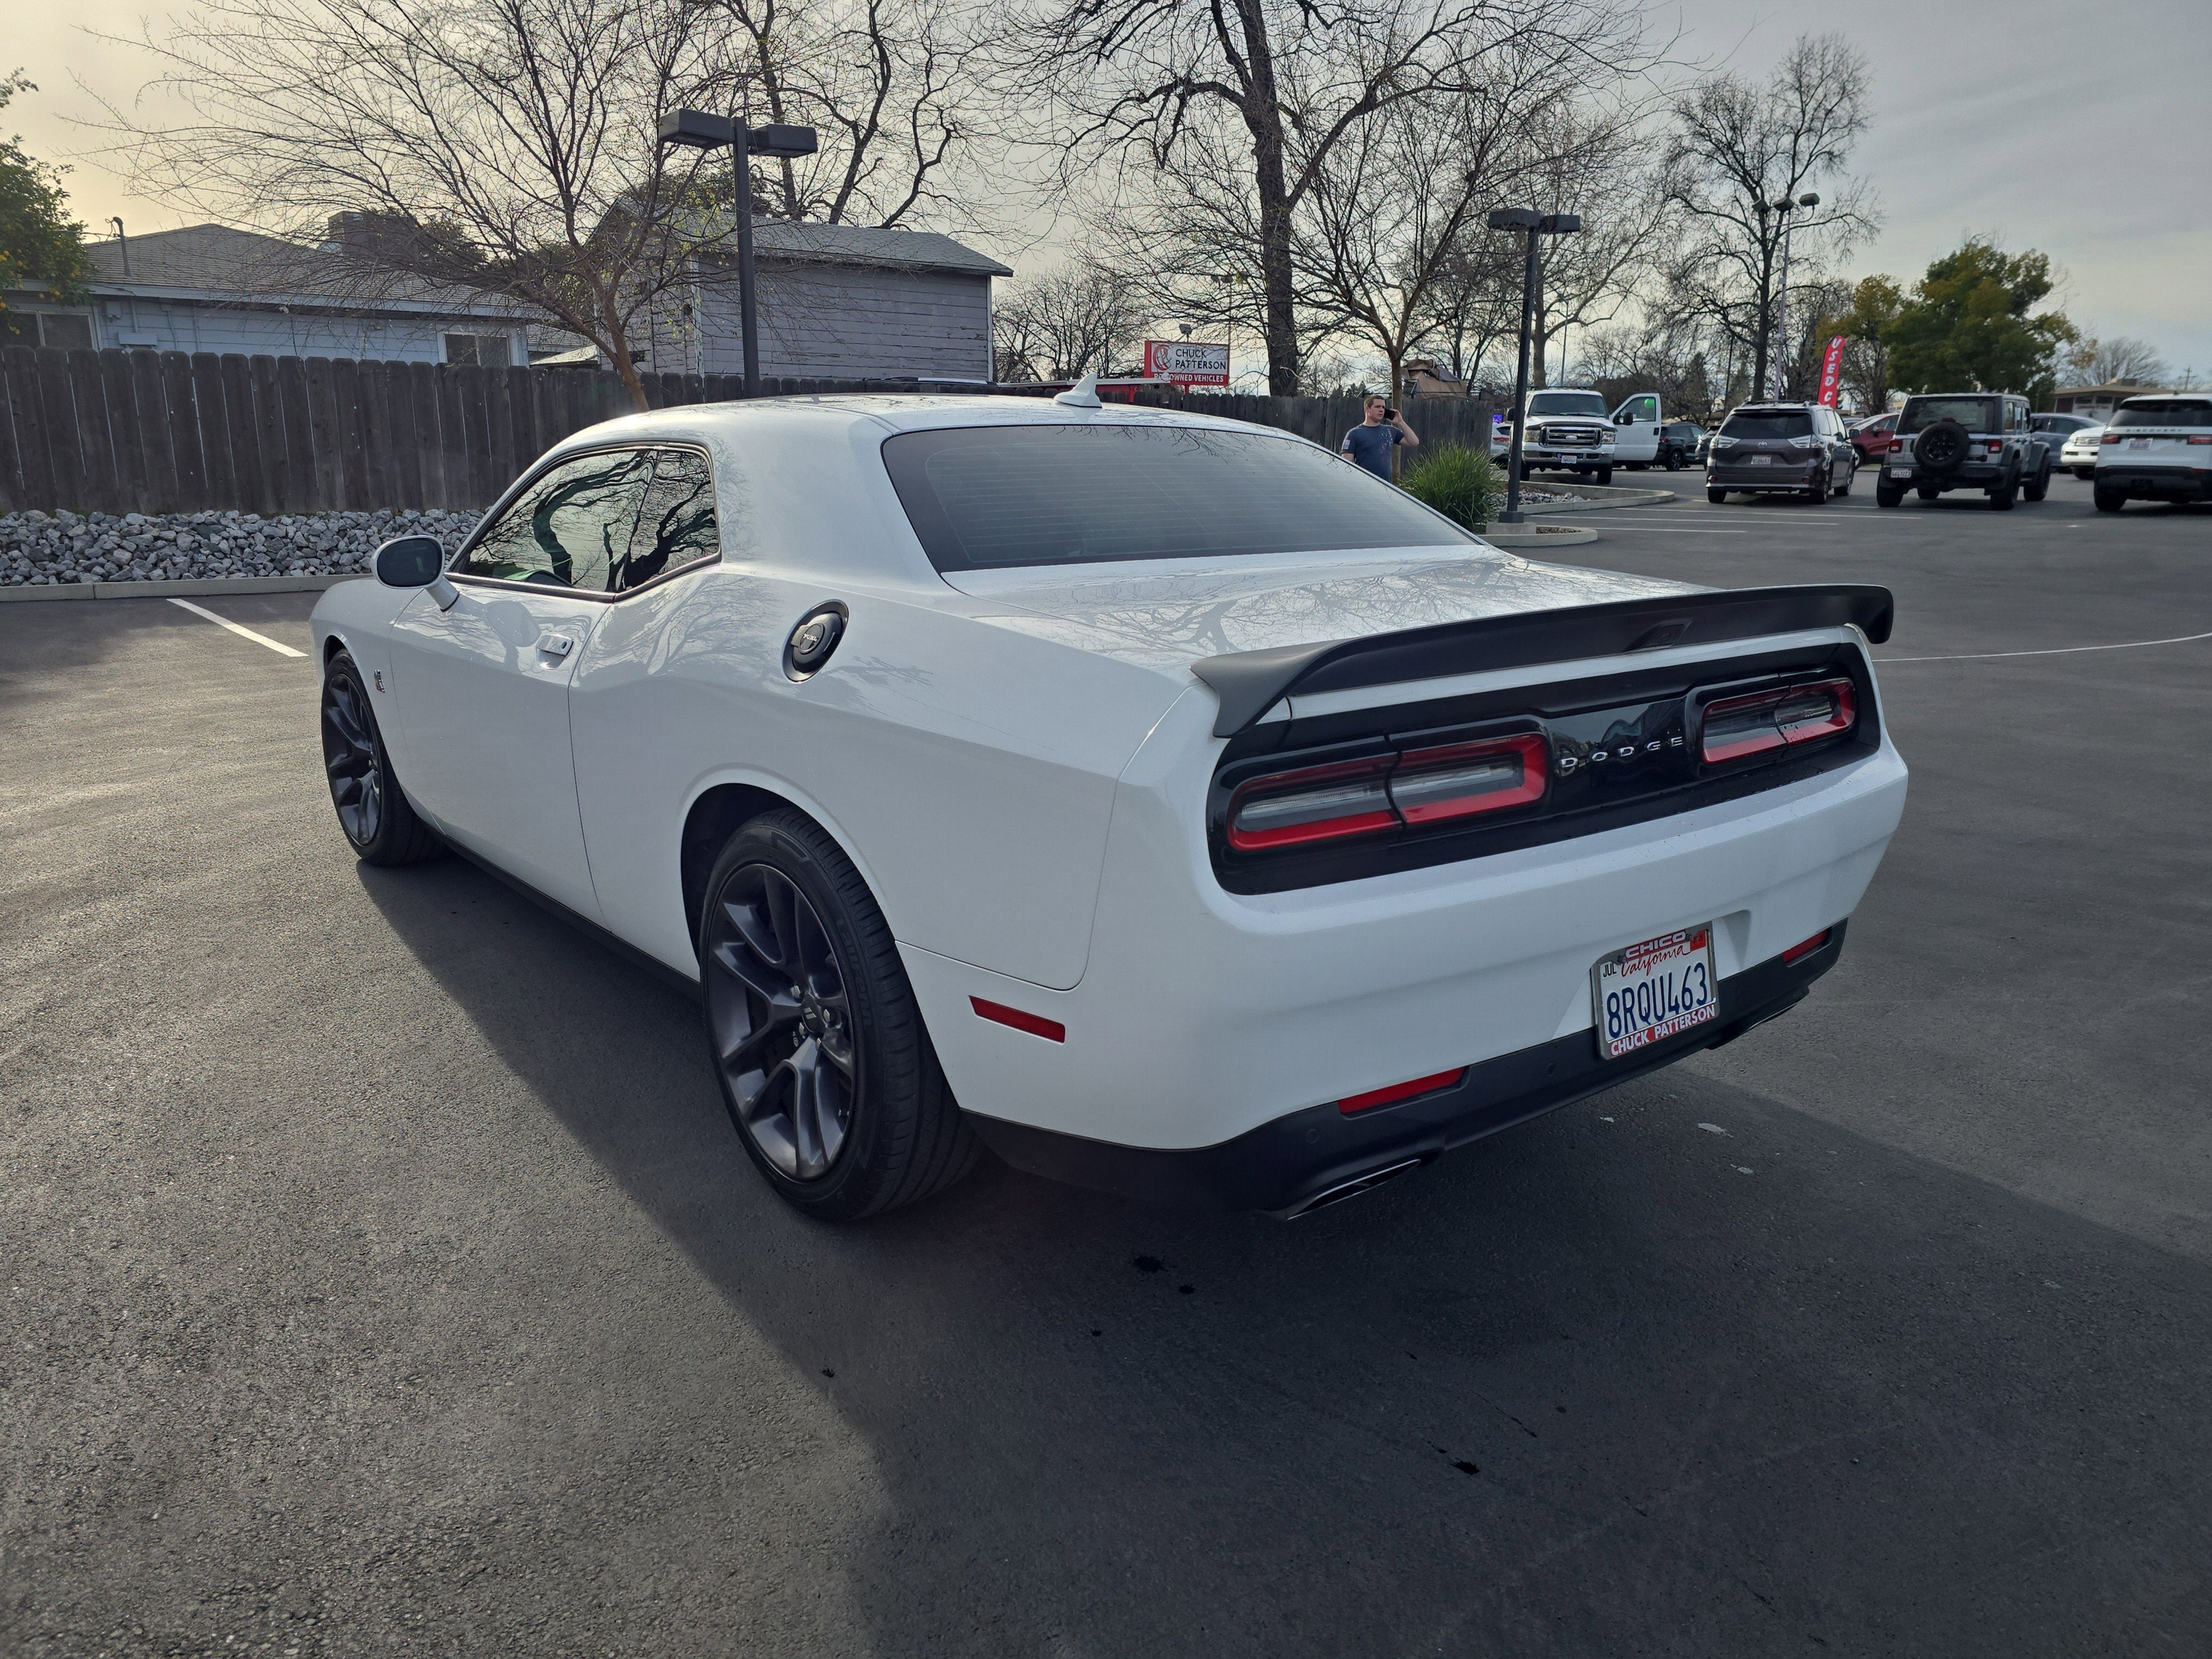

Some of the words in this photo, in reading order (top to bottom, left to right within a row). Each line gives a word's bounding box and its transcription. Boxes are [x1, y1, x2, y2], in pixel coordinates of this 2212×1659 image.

[1175, 349, 1207, 358] CHUCK
[1175, 359, 1226, 370] PATTERSON
[1825, 338, 1842, 387] USED
[1194, 374, 1224, 382] VEHICLES
[1560, 736, 1683, 768] DODGE
[1625, 931, 1686, 959] CHICO
[1603, 963, 1617, 978] JUL
[1621, 946, 1691, 977] California
[1606, 962, 1707, 1039] 8RQU463
[1611, 1031, 1650, 1056] CHUCK
[1655, 1004, 1715, 1039] PATTERSON
